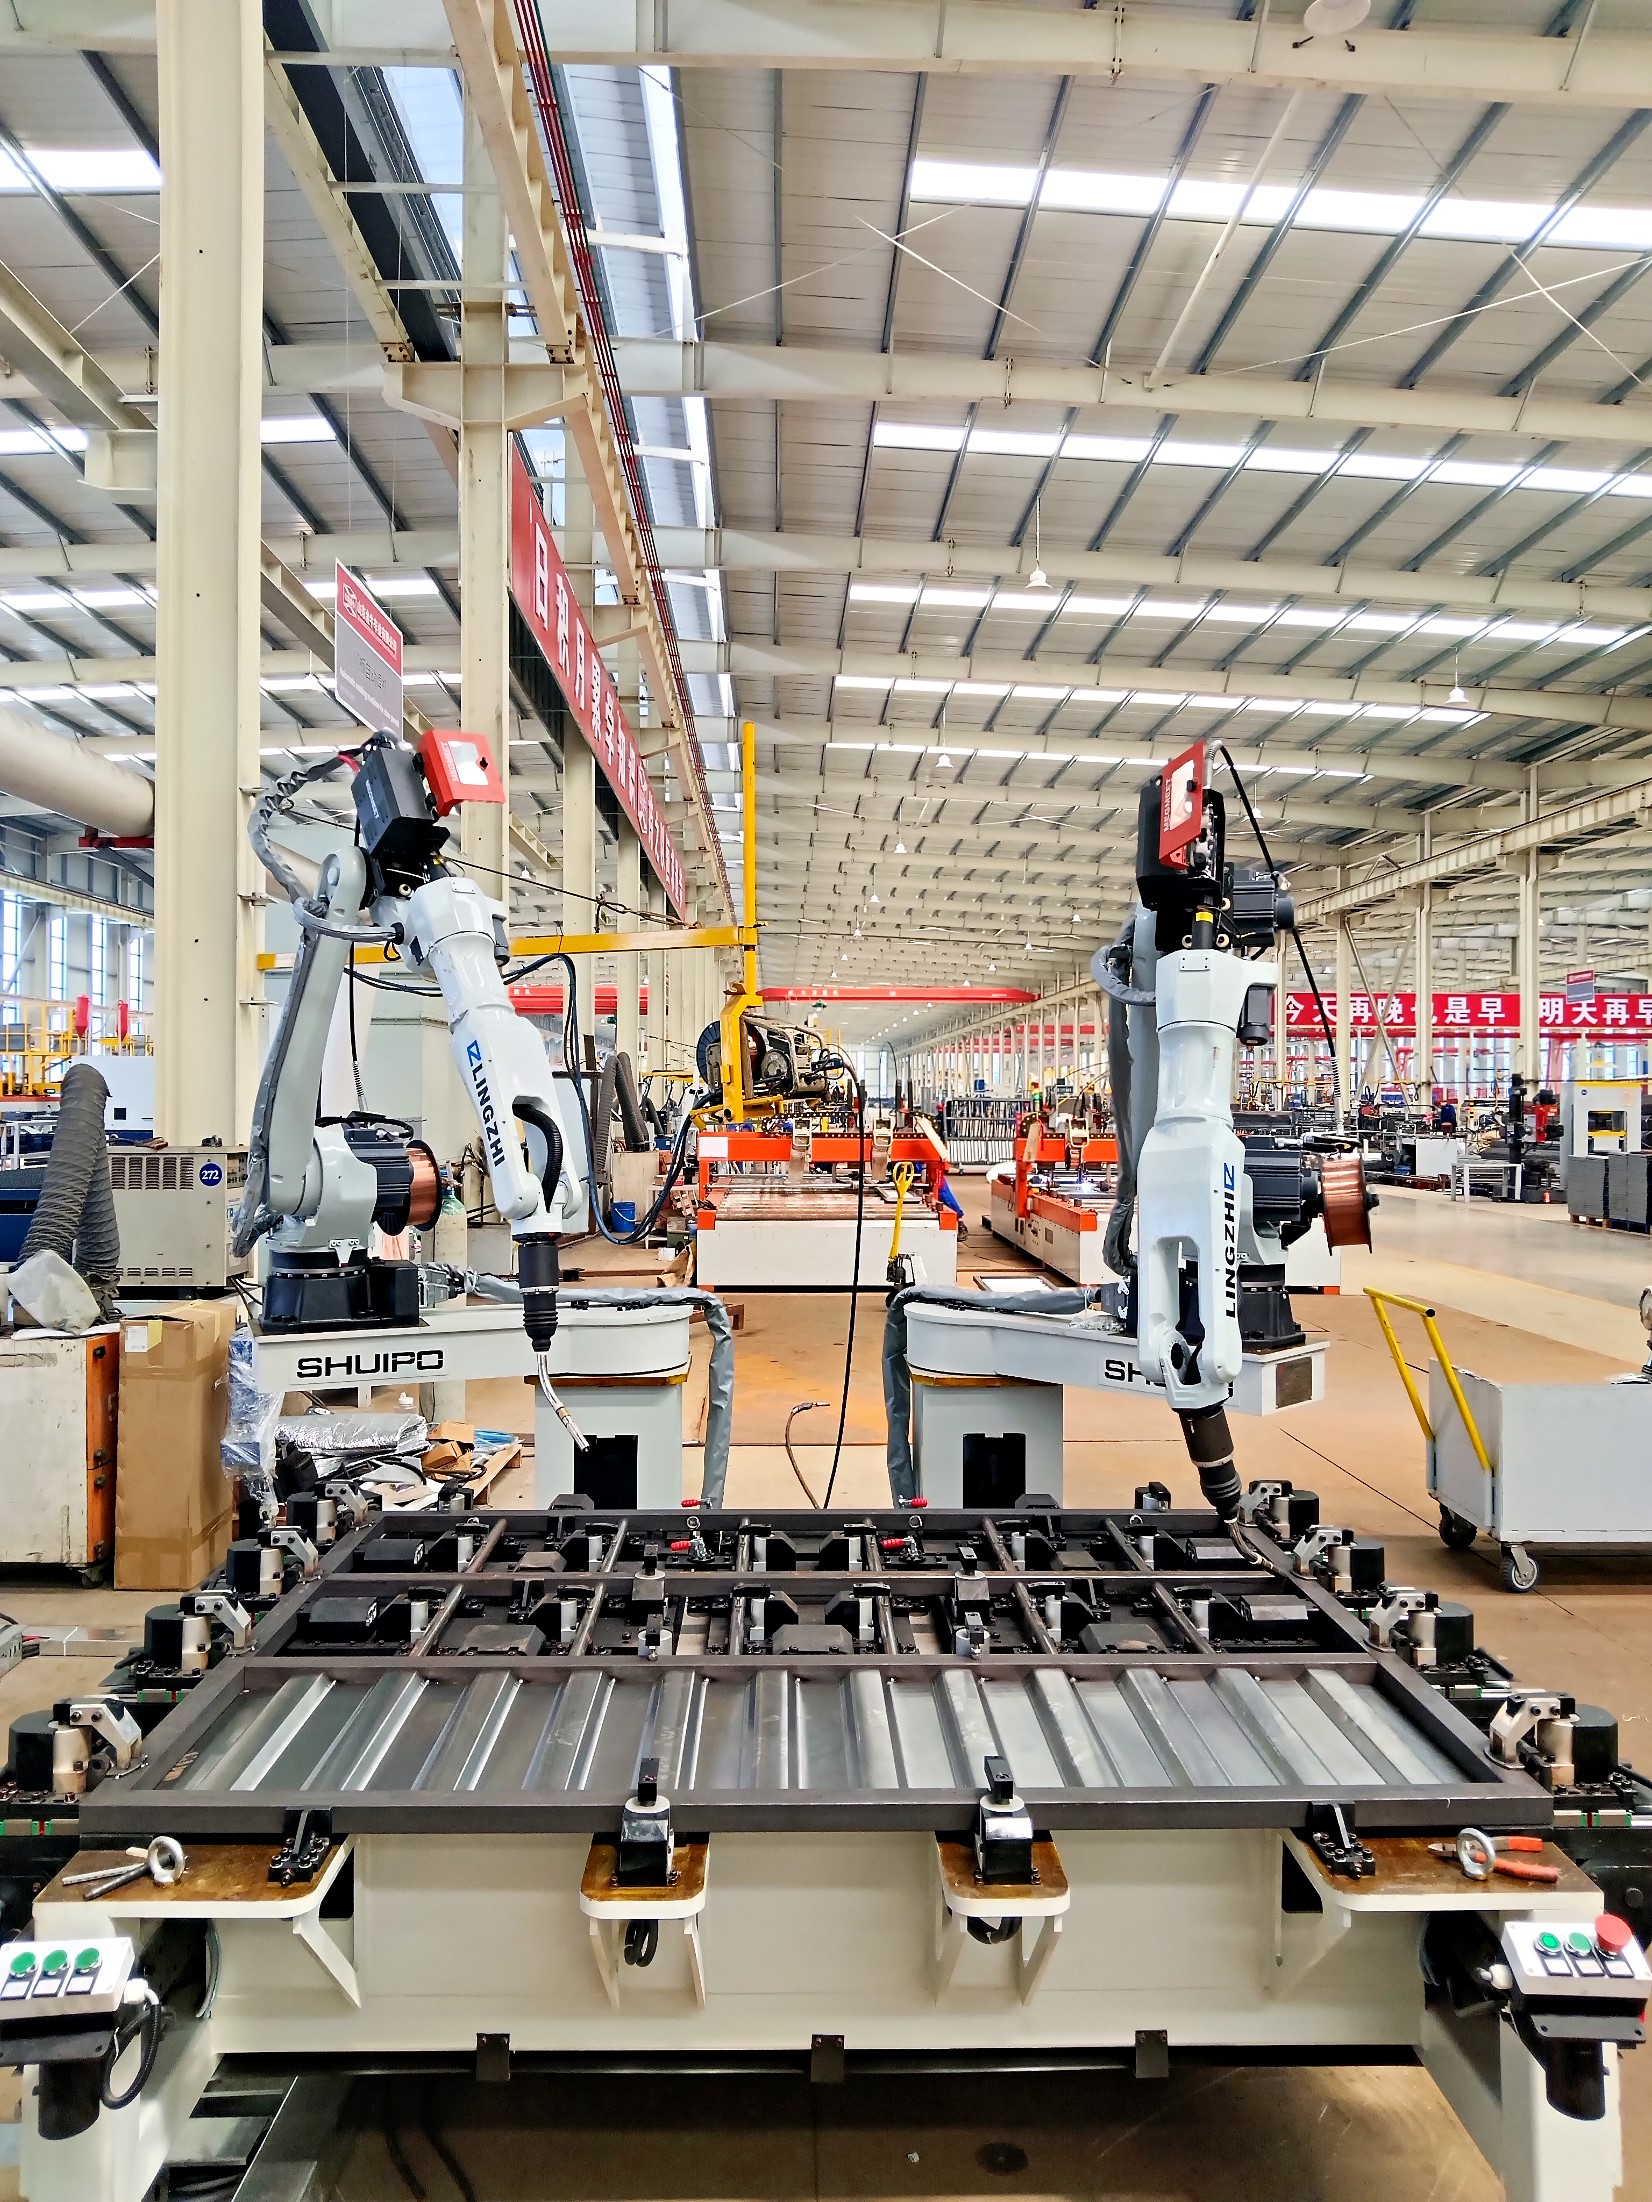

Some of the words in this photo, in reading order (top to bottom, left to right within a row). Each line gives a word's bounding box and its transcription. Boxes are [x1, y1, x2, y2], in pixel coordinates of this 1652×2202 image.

[1163, 778, 1171, 832] MEGMEET
[471, 1063, 507, 1168] LINGZHI
[201, 1169, 220, 1180] 272
[1223, 1191, 1236, 1319] LINGZHI
[296, 1349, 444, 1379] SHUIPO
